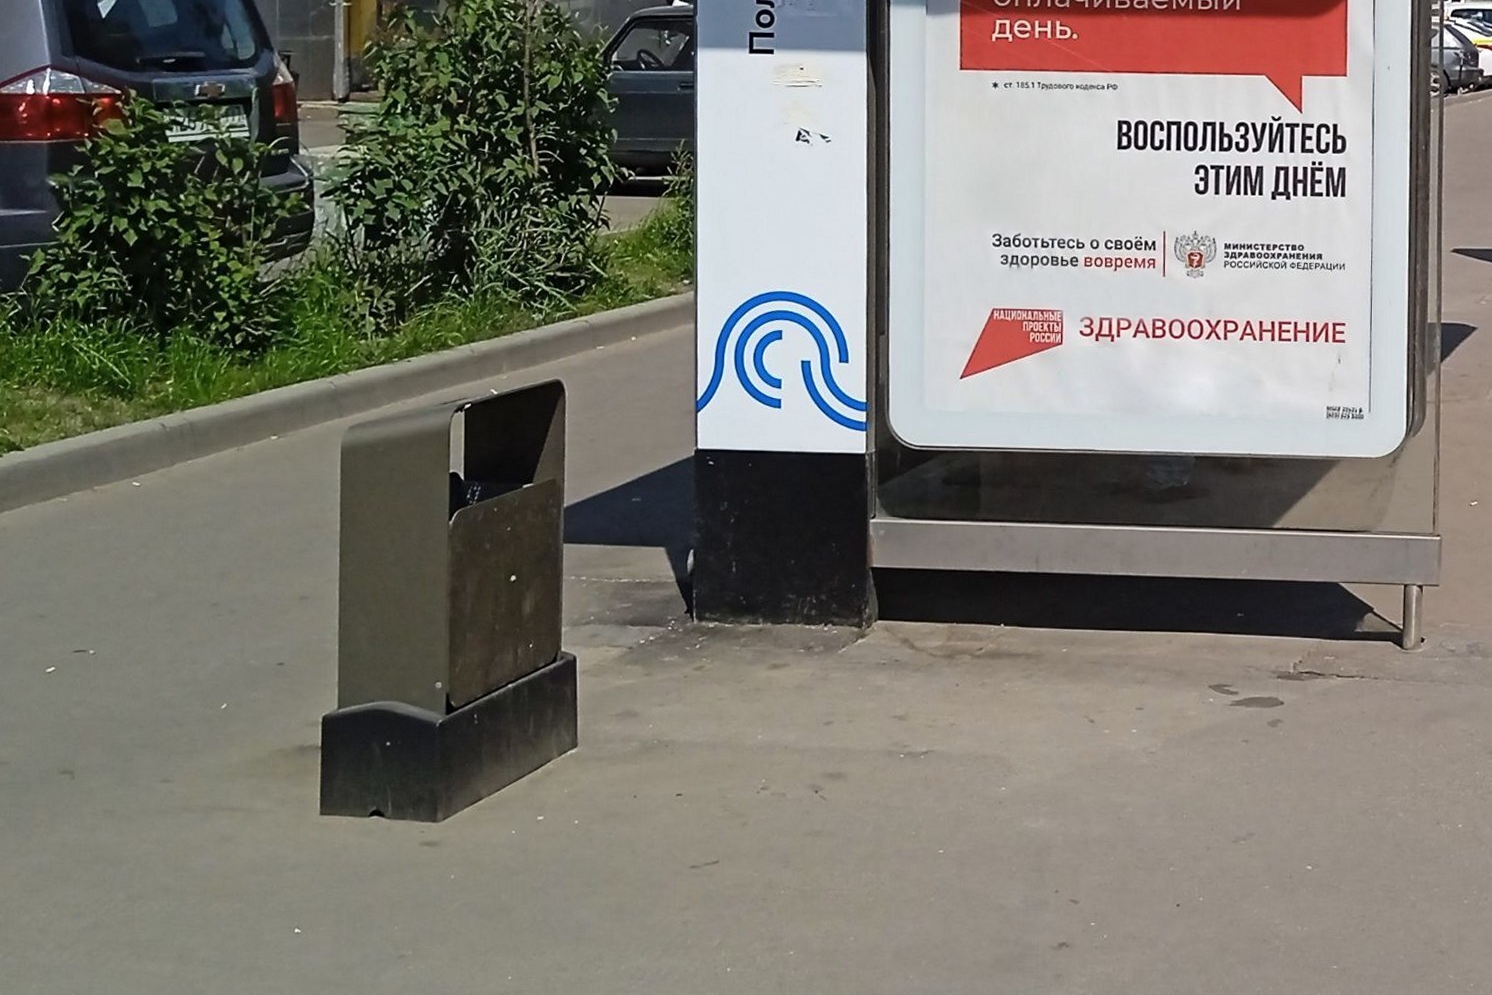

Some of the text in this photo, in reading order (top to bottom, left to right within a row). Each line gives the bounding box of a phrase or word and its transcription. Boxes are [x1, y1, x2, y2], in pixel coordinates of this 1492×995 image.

[991, 18, 1079, 42] день.
[1106, 83, 1119, 91] РФ
[1116, 116, 1347, 154] ВОСПОЛЬЗУЙТЕСЬ
[1194, 161, 1346, 200] ЭТИМ ДНЁМ
[992, 233, 1156, 251] Заботьтесь о своём
[1223, 243, 1305, 251] МИНИСТЕРСТВО
[1223, 251, 1323, 260] ЗДРАВООХРАНЕНИЯ
[1000, 254, 1156, 271] здоровье вовремя
[1223, 260, 1346, 271] РОССИЙСКОЙ ФЕДЕРАЦИИ
[993, 310, 1062, 322] НАЦИОНАЛЬНЫЕ
[1023, 321, 1062, 332] ПРОЕКТЫ
[1079, 316, 1346, 344] ЗДРАВООХРАНЕНИЕ
[1029, 332, 1061, 343] РОССИИ
